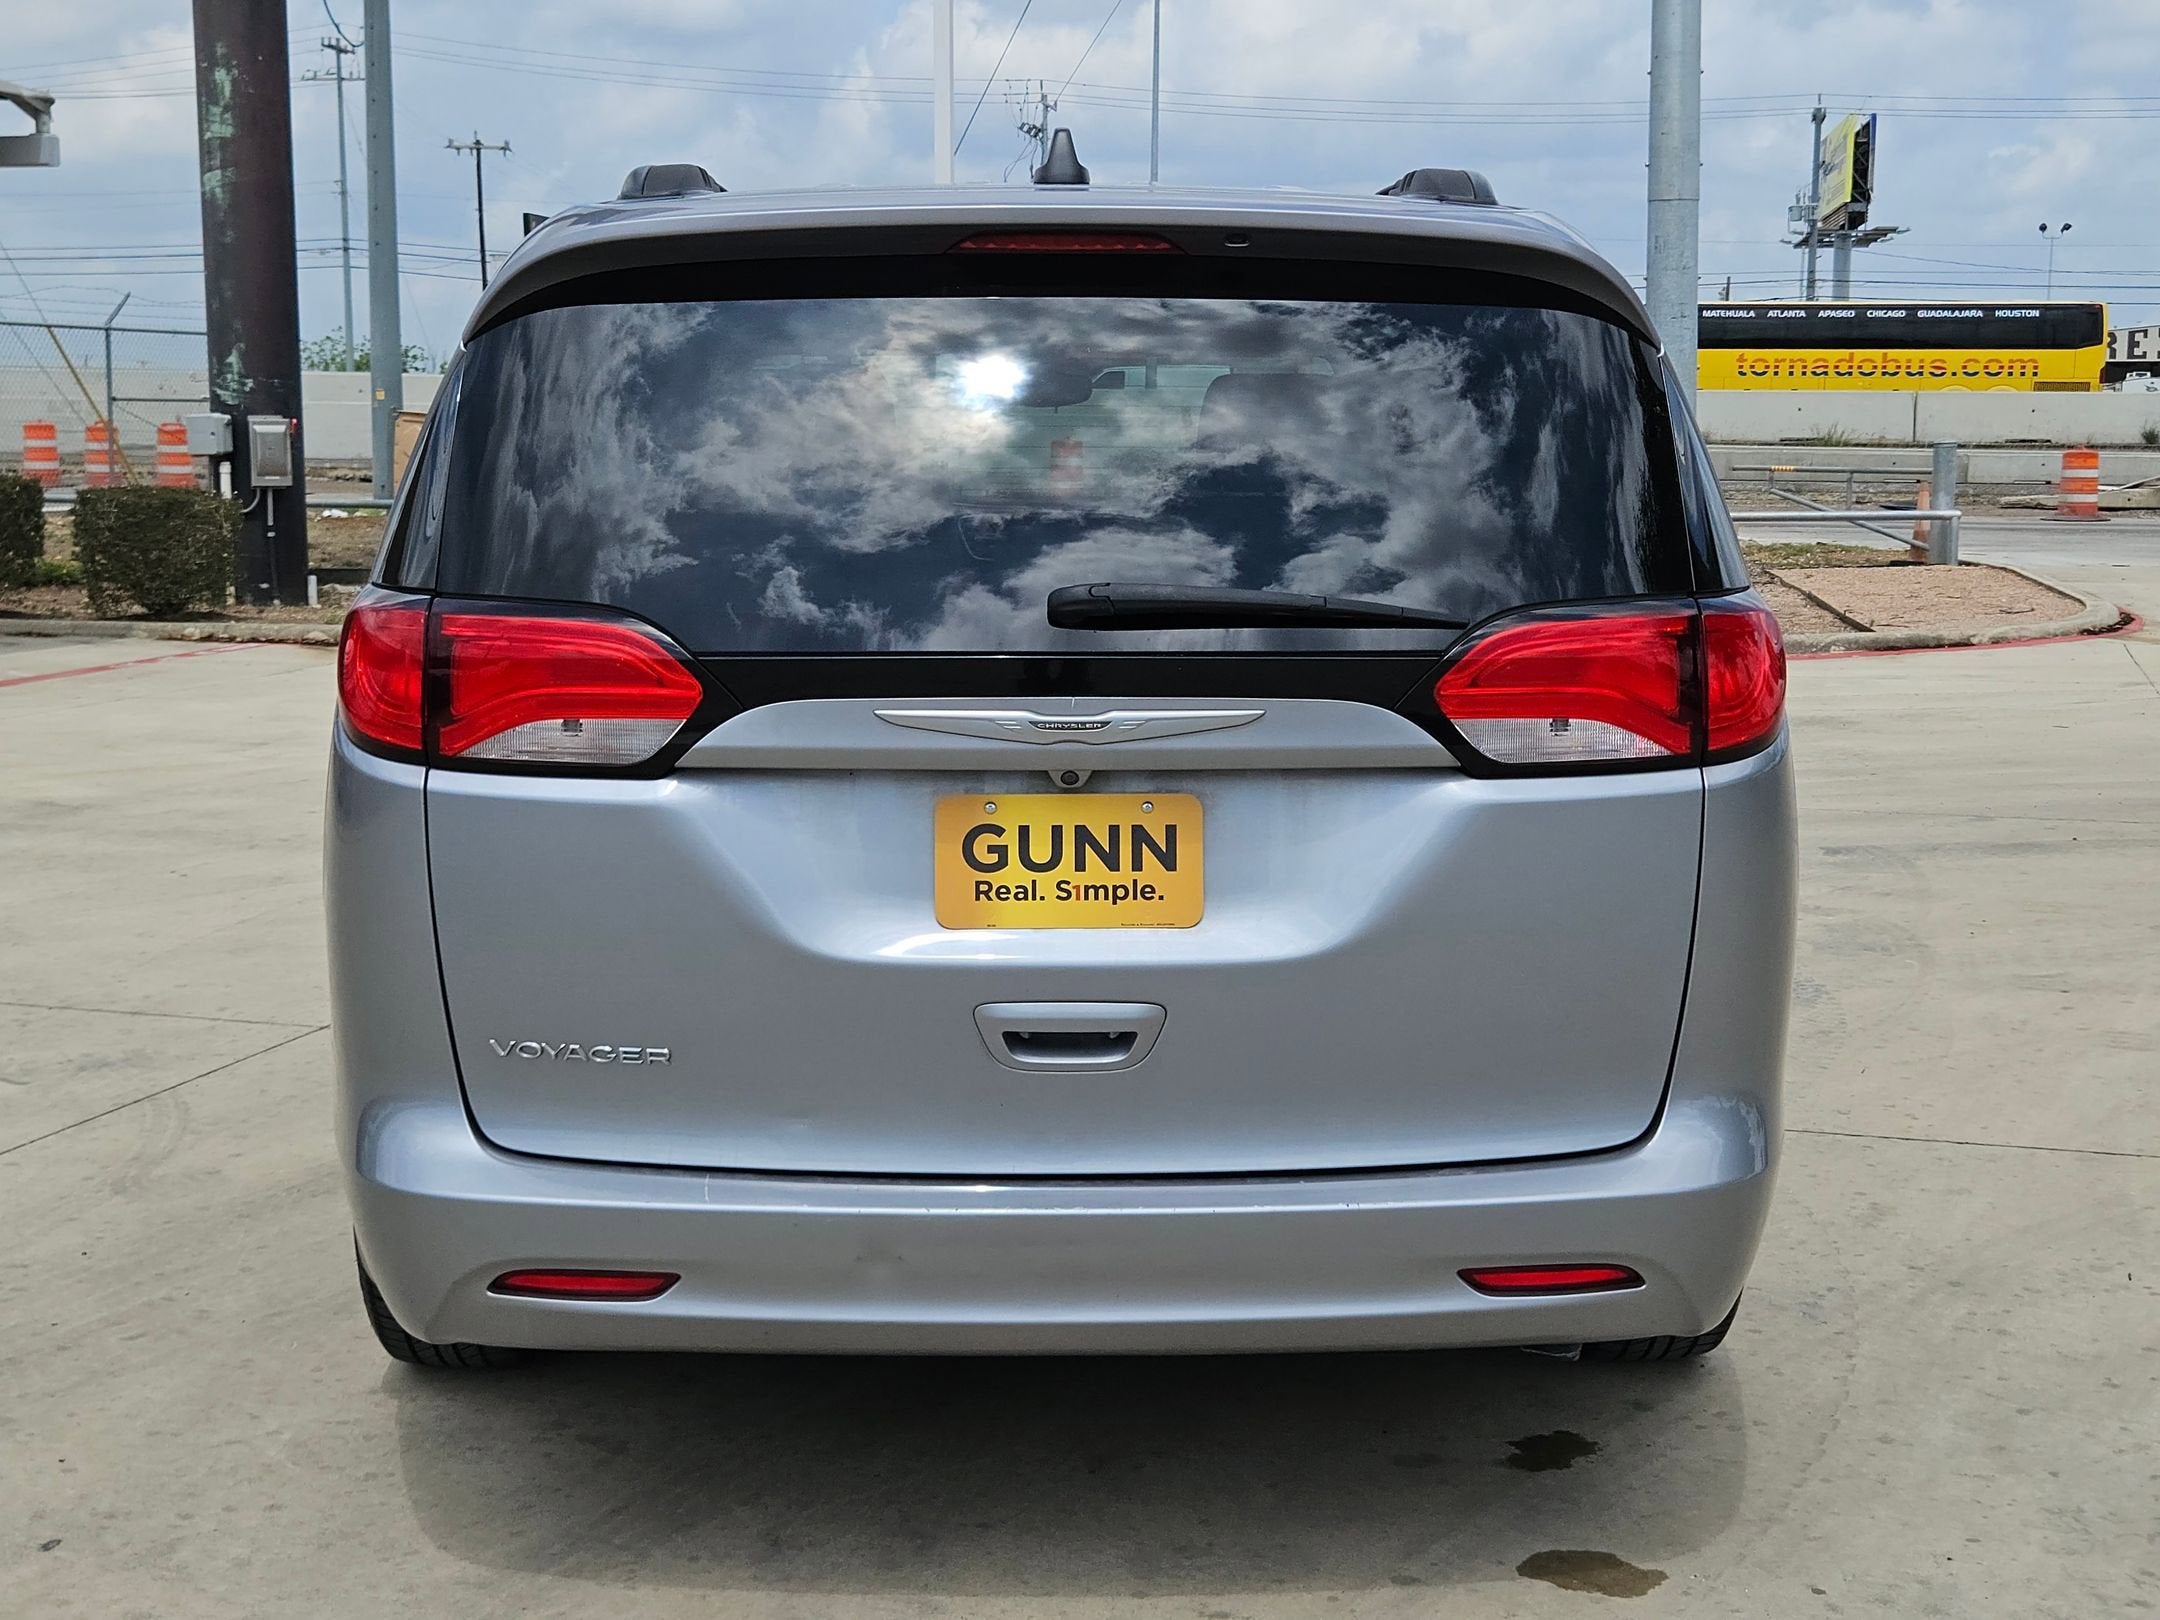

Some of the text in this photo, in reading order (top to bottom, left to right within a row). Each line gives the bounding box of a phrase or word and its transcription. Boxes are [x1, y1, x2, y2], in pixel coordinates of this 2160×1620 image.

[1702, 309, 2040, 318] MATEHUALA ATLANTA APASEO CHICAGO GUADALAJARA HOUSTON
[1736, 352, 2039, 377] tornadobus.com
[961, 823, 1178, 873] GUNN
[974, 879, 1046, 902] Real.
[489, 1038, 671, 1065] VOYAGER
